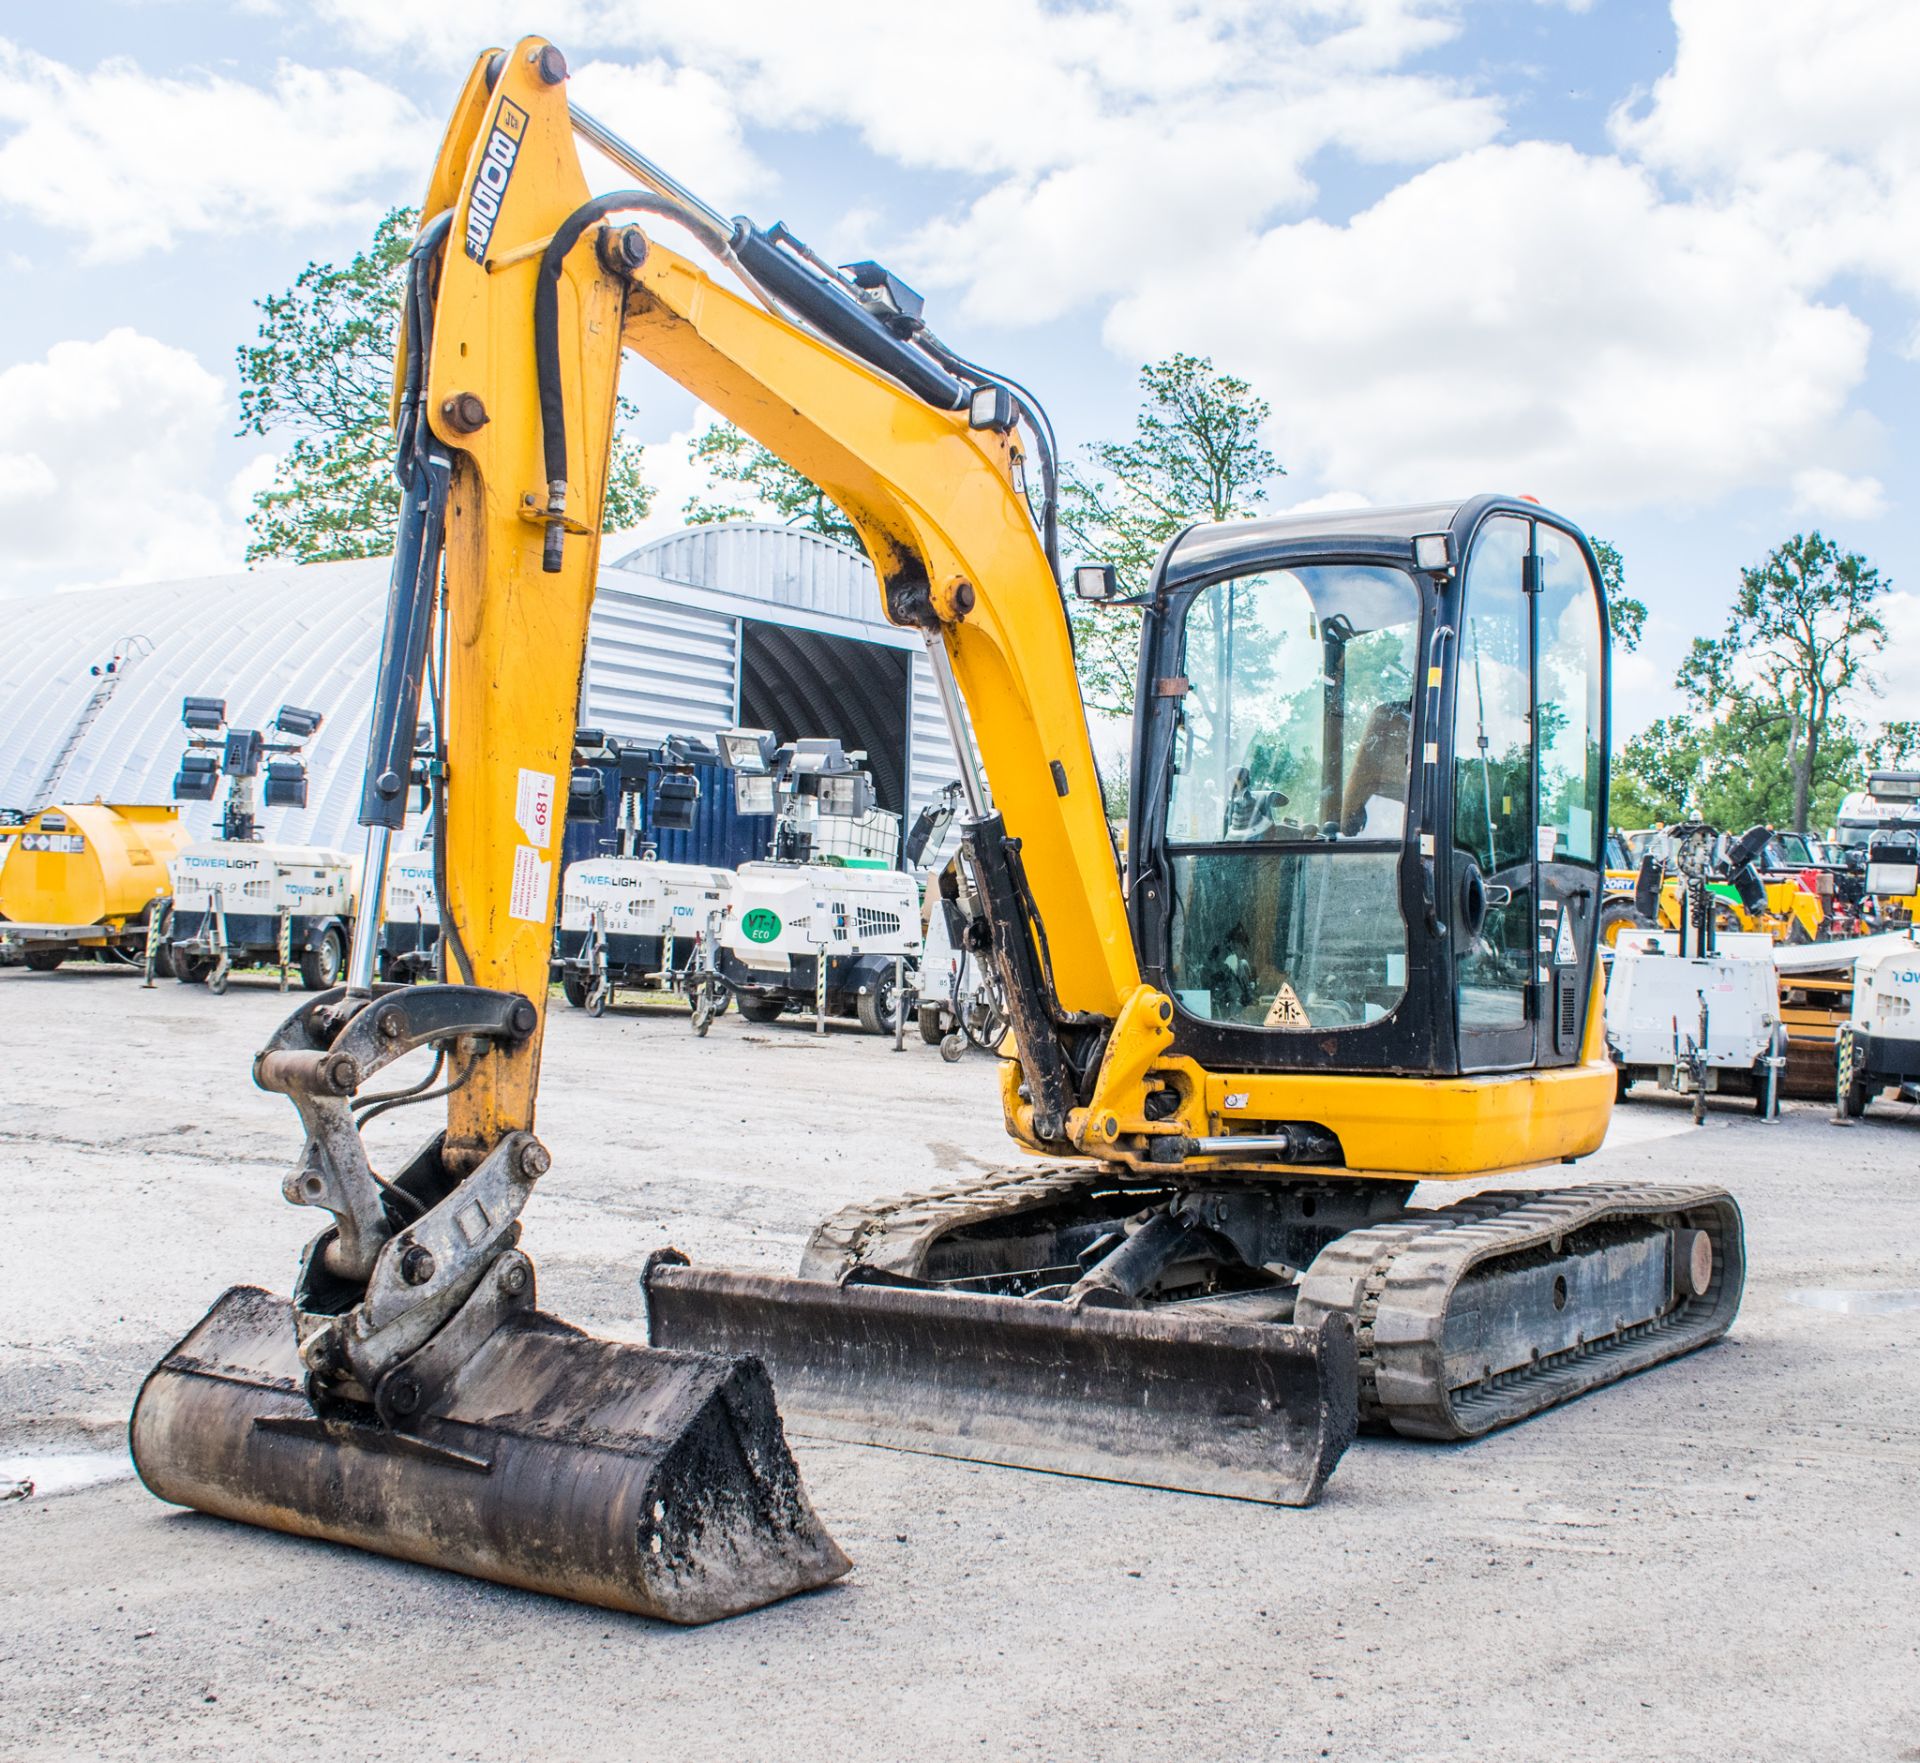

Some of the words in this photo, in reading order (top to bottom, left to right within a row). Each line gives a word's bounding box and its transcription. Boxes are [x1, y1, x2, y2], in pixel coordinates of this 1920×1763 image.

[535, 792, 548, 825] 681
[184, 857, 260, 869] TOWERLIGHT
[752, 930, 770, 939] ECO
